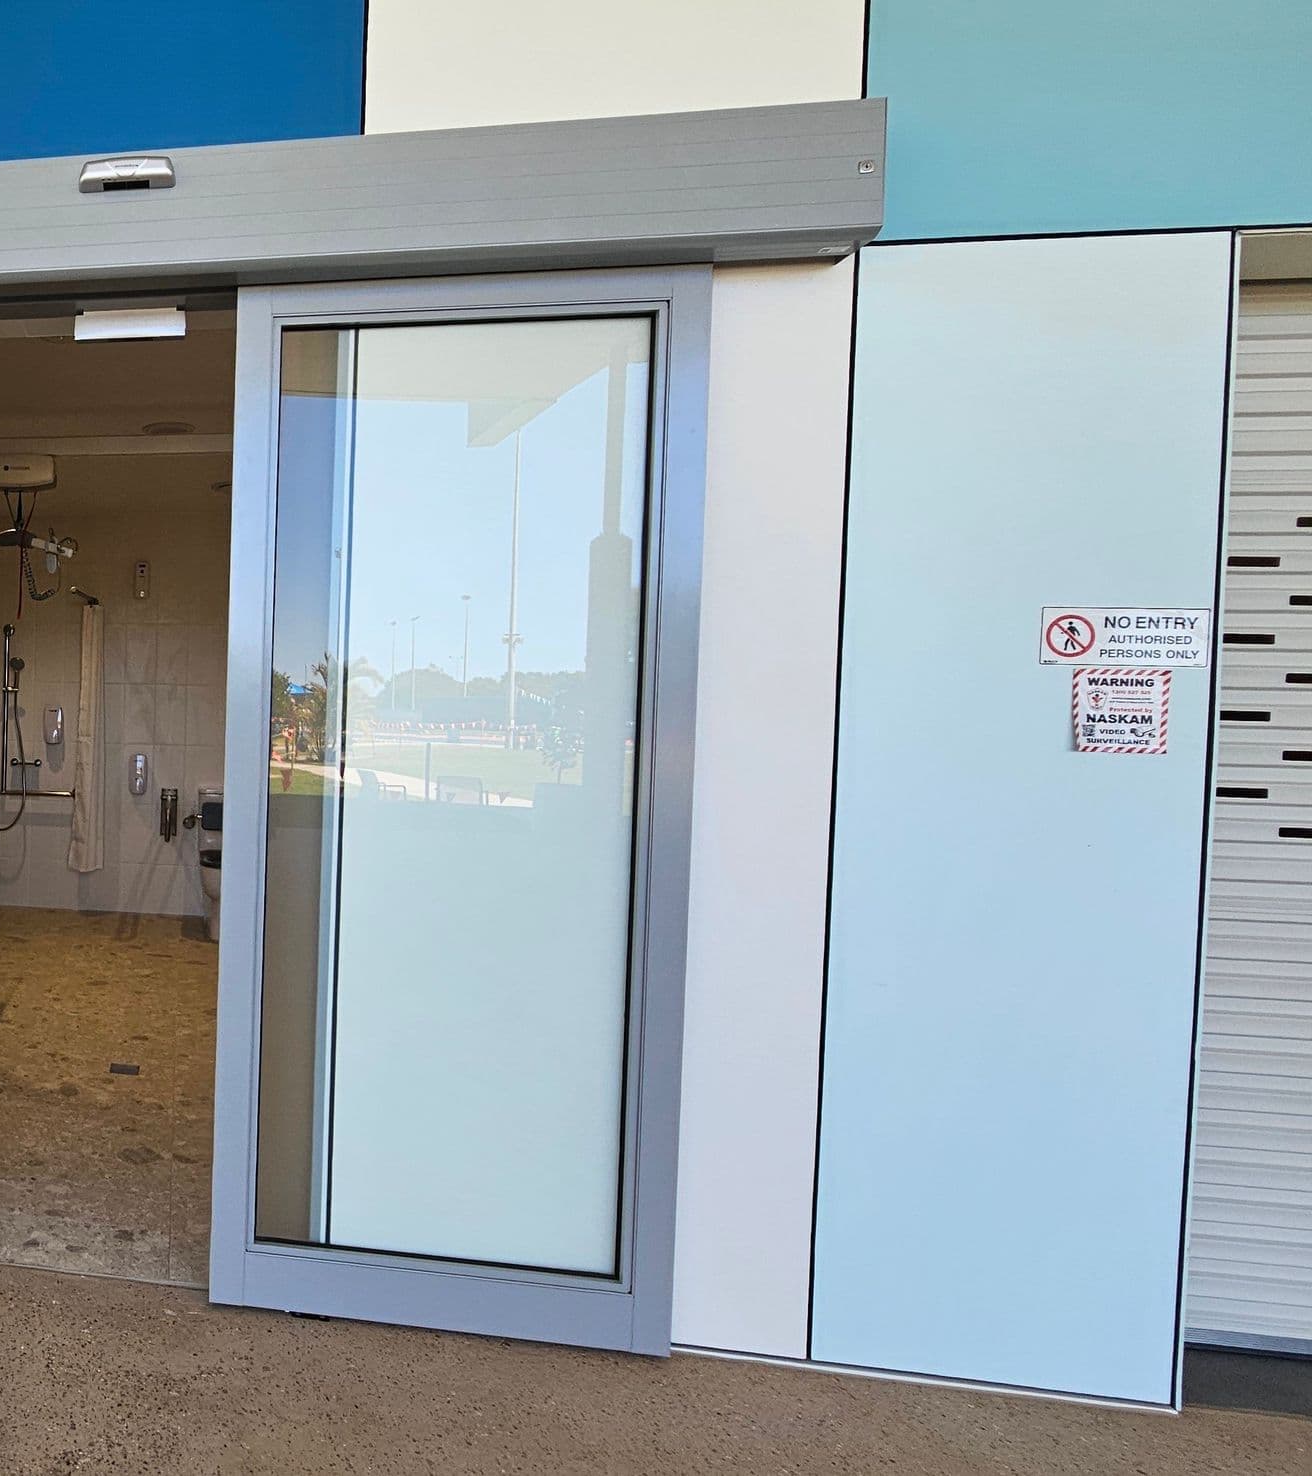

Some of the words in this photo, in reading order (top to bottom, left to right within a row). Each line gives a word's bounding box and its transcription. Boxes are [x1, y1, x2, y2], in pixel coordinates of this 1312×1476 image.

[1104, 616, 1131, 629] NO
[1135, 616, 1199, 630] ENTRY
[1108, 635, 1193, 645] AUTHORISED
[1099, 649, 1162, 659] PERSONS
[1166, 650, 1200, 659] ONLY
[1088, 677, 1155, 688] WARNING
[1086, 714, 1153, 724] NASKAM
